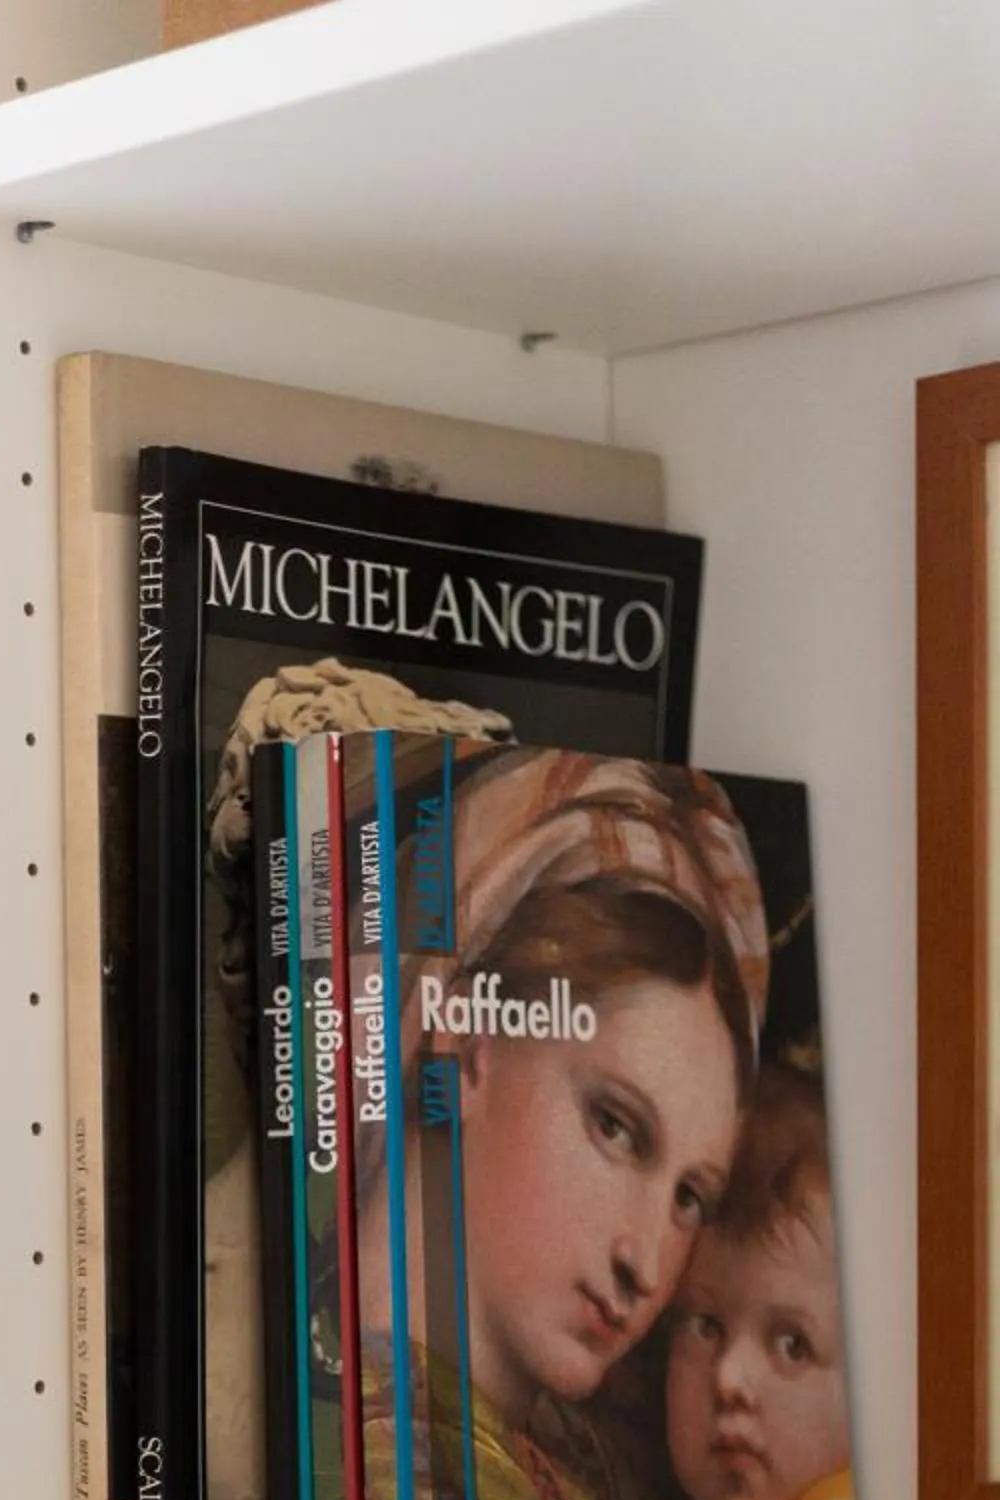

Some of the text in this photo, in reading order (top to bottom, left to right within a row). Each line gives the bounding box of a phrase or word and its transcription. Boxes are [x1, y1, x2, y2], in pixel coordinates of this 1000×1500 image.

[138, 492, 164, 758] MICHELANGELO
[206, 532, 664, 671] MICHELANGELO
[269, 837, 289, 957] VITA D'ARTISTA
[312, 829, 332, 948] VITA D'ARTISTA
[360, 821, 382, 944] VITA D'ARTISTA
[264, 986, 294, 1139] Leonardo
[353, 975, 385, 1123] Raffaello
[421, 972, 597, 1041] Raffaello
[305, 977, 343, 1174] Caravaggio
[422, 1062, 452, 1125] VITA
[75, 1118, 87, 1173] JAMES
[75, 1186, 87, 1246] HENRY
[76, 1256, 87, 1278] BY
